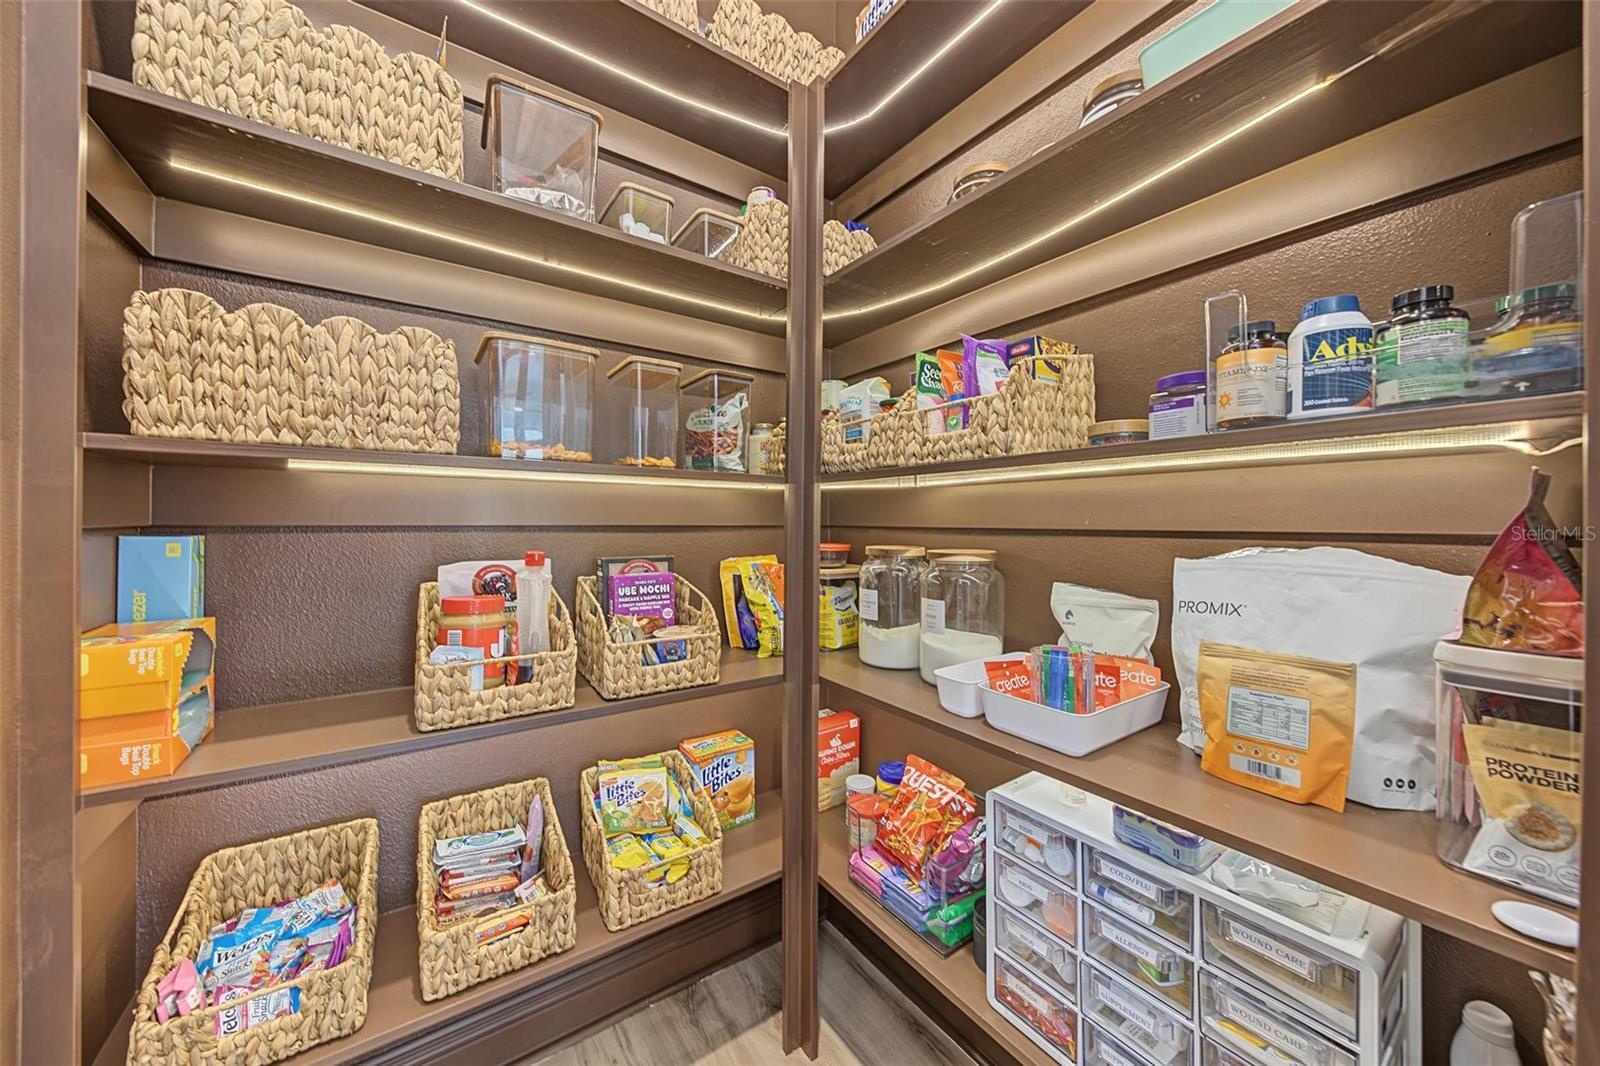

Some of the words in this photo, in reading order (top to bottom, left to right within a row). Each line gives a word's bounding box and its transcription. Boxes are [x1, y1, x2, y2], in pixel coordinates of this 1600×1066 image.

[921, 375, 944, 390] Cha
[924, 363, 942, 378] See
[618, 587, 636, 596] UBE
[639, 584, 669, 594] MOCHI
[1178, 599, 1243, 618] PROMIX
[996, 673, 1030, 692] create
[818, 748, 838, 758] WANS
[702, 757, 733, 787] Little
[711, 766, 742, 794] Bites
[1485, 757, 1580, 784] PROTEIN
[1488, 768, 1580, 794] POWDER
[606, 780, 635, 801] Little
[617, 789, 646, 807] Bites
[1109, 867, 1151, 892] COLD/FLU
[216, 932, 274, 964] Welch's
[1114, 934, 1150, 957] ALLERGY
[1232, 925, 1273, 952] WOUND
[1275, 947, 1307, 970] CARE
[223, 991, 238, 1035] elcs
[1100, 991, 1152, 1030] SUPPLEMENT
[1231, 1004, 1272, 1031] WOUND
[1274, 1030, 1305, 1050] CARE
